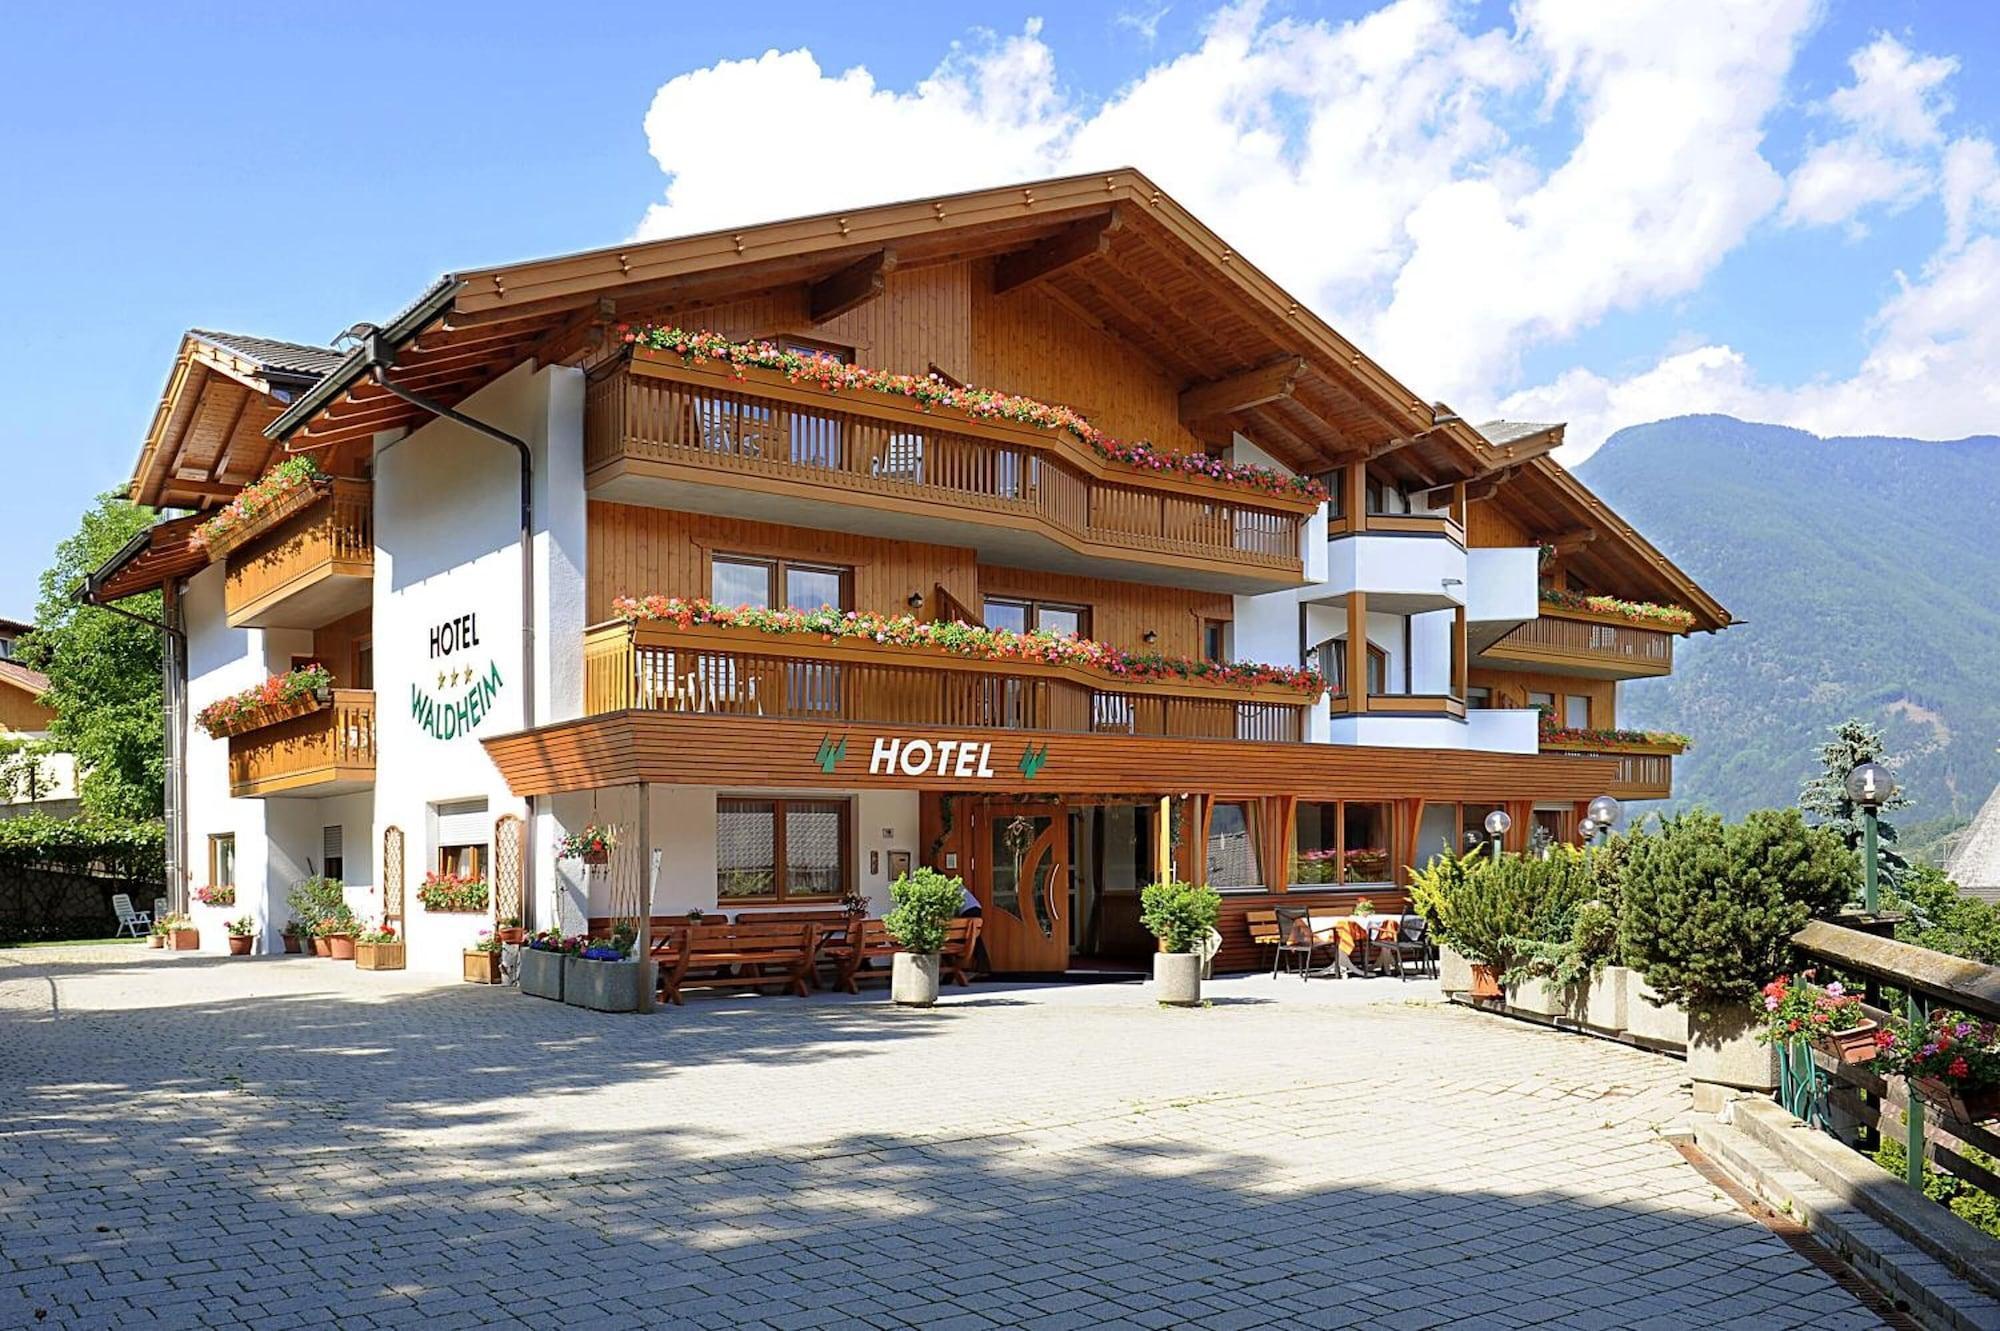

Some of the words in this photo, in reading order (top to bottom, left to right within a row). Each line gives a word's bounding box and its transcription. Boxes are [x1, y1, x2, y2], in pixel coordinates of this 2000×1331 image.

[430, 612, 480, 659] HOTEL
[412, 659, 504, 741] WALDHEIM
[869, 737, 995, 779] HOTEL
